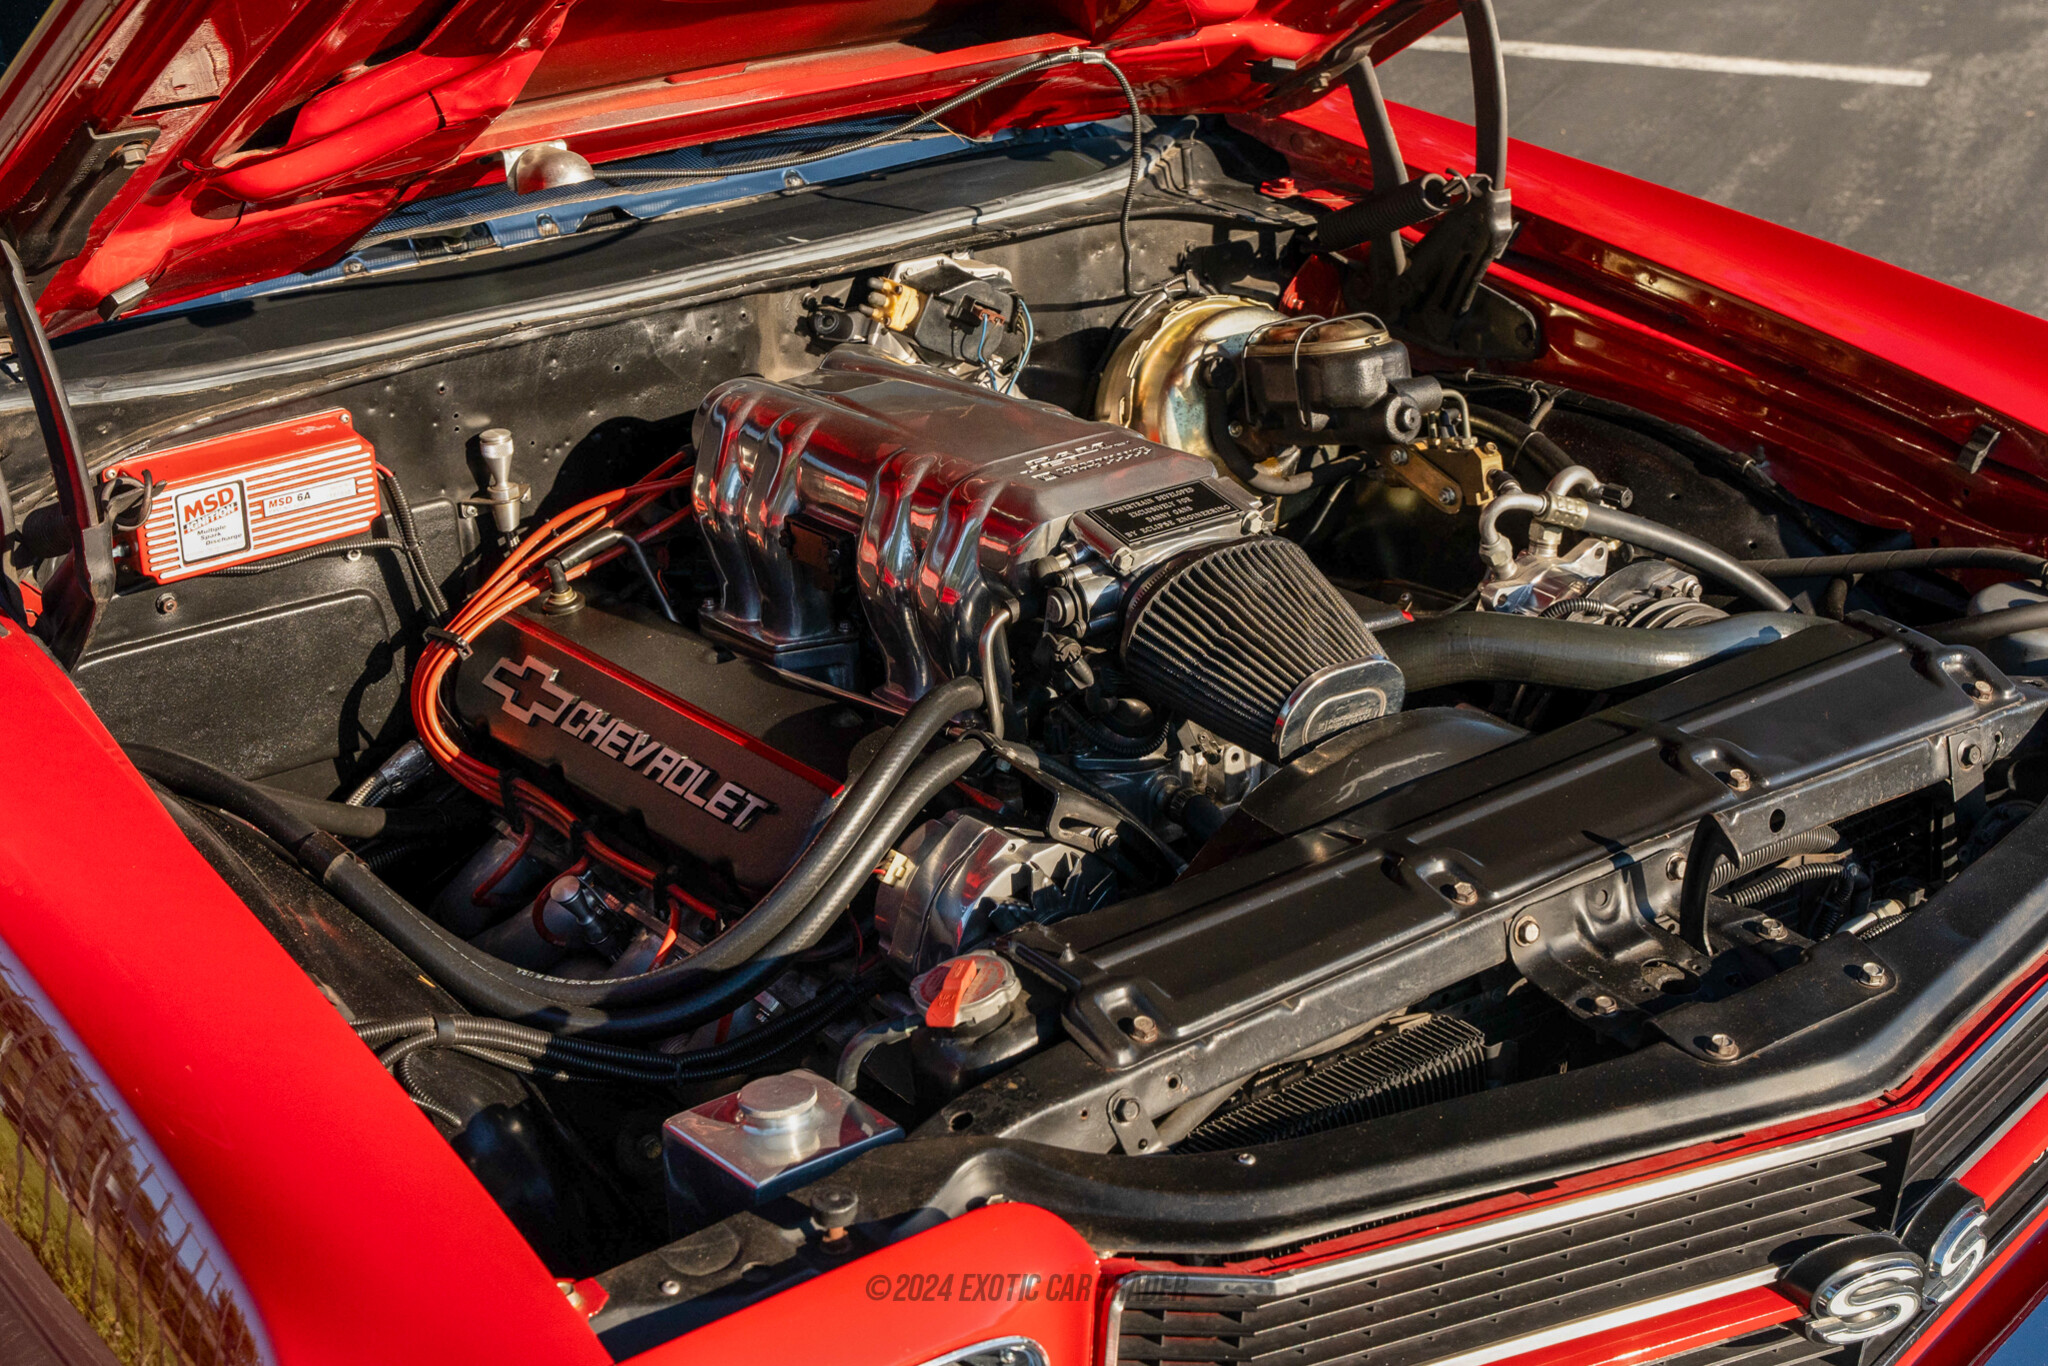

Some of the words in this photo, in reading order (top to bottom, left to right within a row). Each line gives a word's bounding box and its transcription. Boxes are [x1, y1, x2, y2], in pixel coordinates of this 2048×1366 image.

[184, 487, 234, 523] MSD
[268, 496, 293, 509] MSD
[297, 491, 311, 501] 6A
[1107, 498, 1155, 516] POWERTRAIN
[1155, 486, 1195, 502] DEVELOPED
[1128, 501, 1176, 519] EXCLUSIVELY
[1177, 496, 1193, 505] FOR
[186, 502, 237, 533] IGNITION
[1124, 530, 1137, 538] BY
[1140, 520, 1175, 534] ECLIPSE
[1175, 504, 1231, 523] ENGINEERING
[1145, 512, 1171, 523] DANNY
[197, 525, 226, 536] Multiple
[201, 532, 221, 541] Spark
[205, 533, 242, 546] Discharge
[560, 700, 770, 829] CHEVROLET
